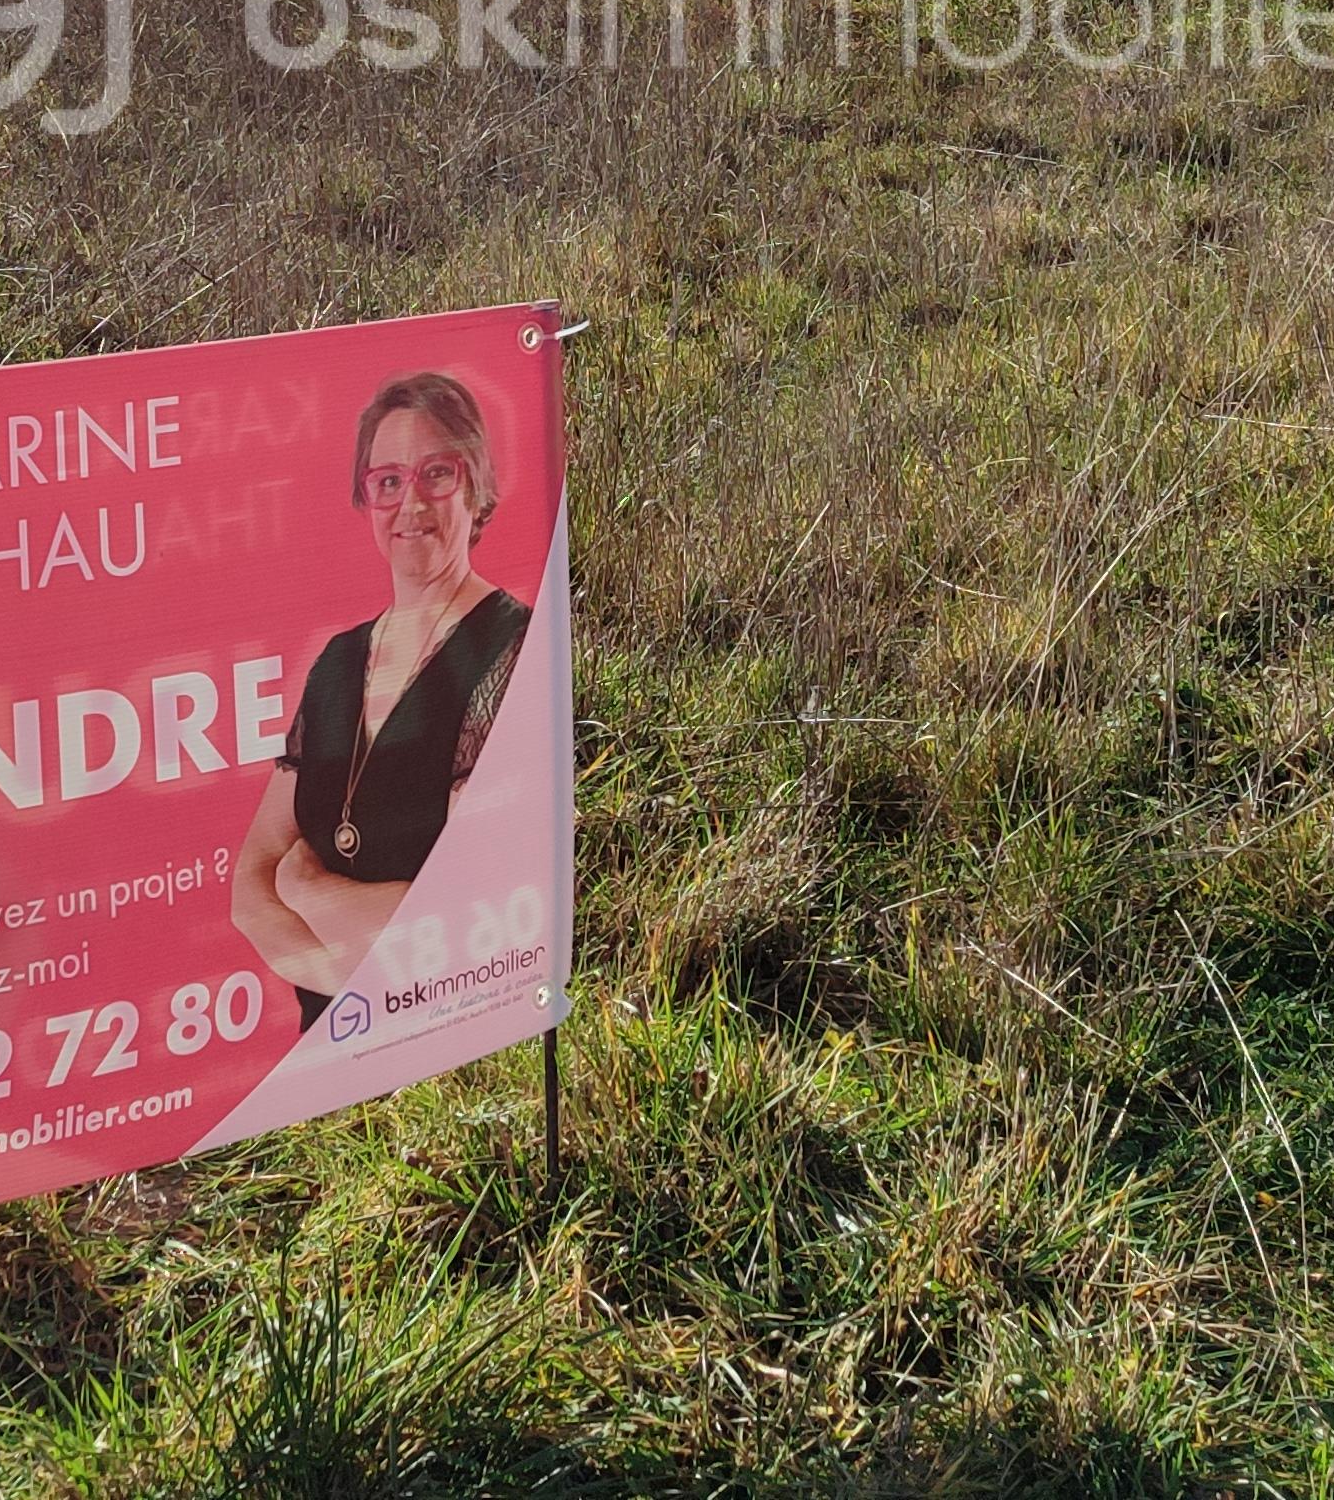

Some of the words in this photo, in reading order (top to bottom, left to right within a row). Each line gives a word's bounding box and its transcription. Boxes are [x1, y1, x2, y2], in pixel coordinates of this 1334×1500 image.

[58, 887, 97, 918] un
[110, 857, 205, 918] projet
[214, 847, 229, 883] ?
[385, 946, 546, 1014] bskimmobilier
[45, 1001, 140, 1089] 72
[166, 971, 264, 1056] 80
